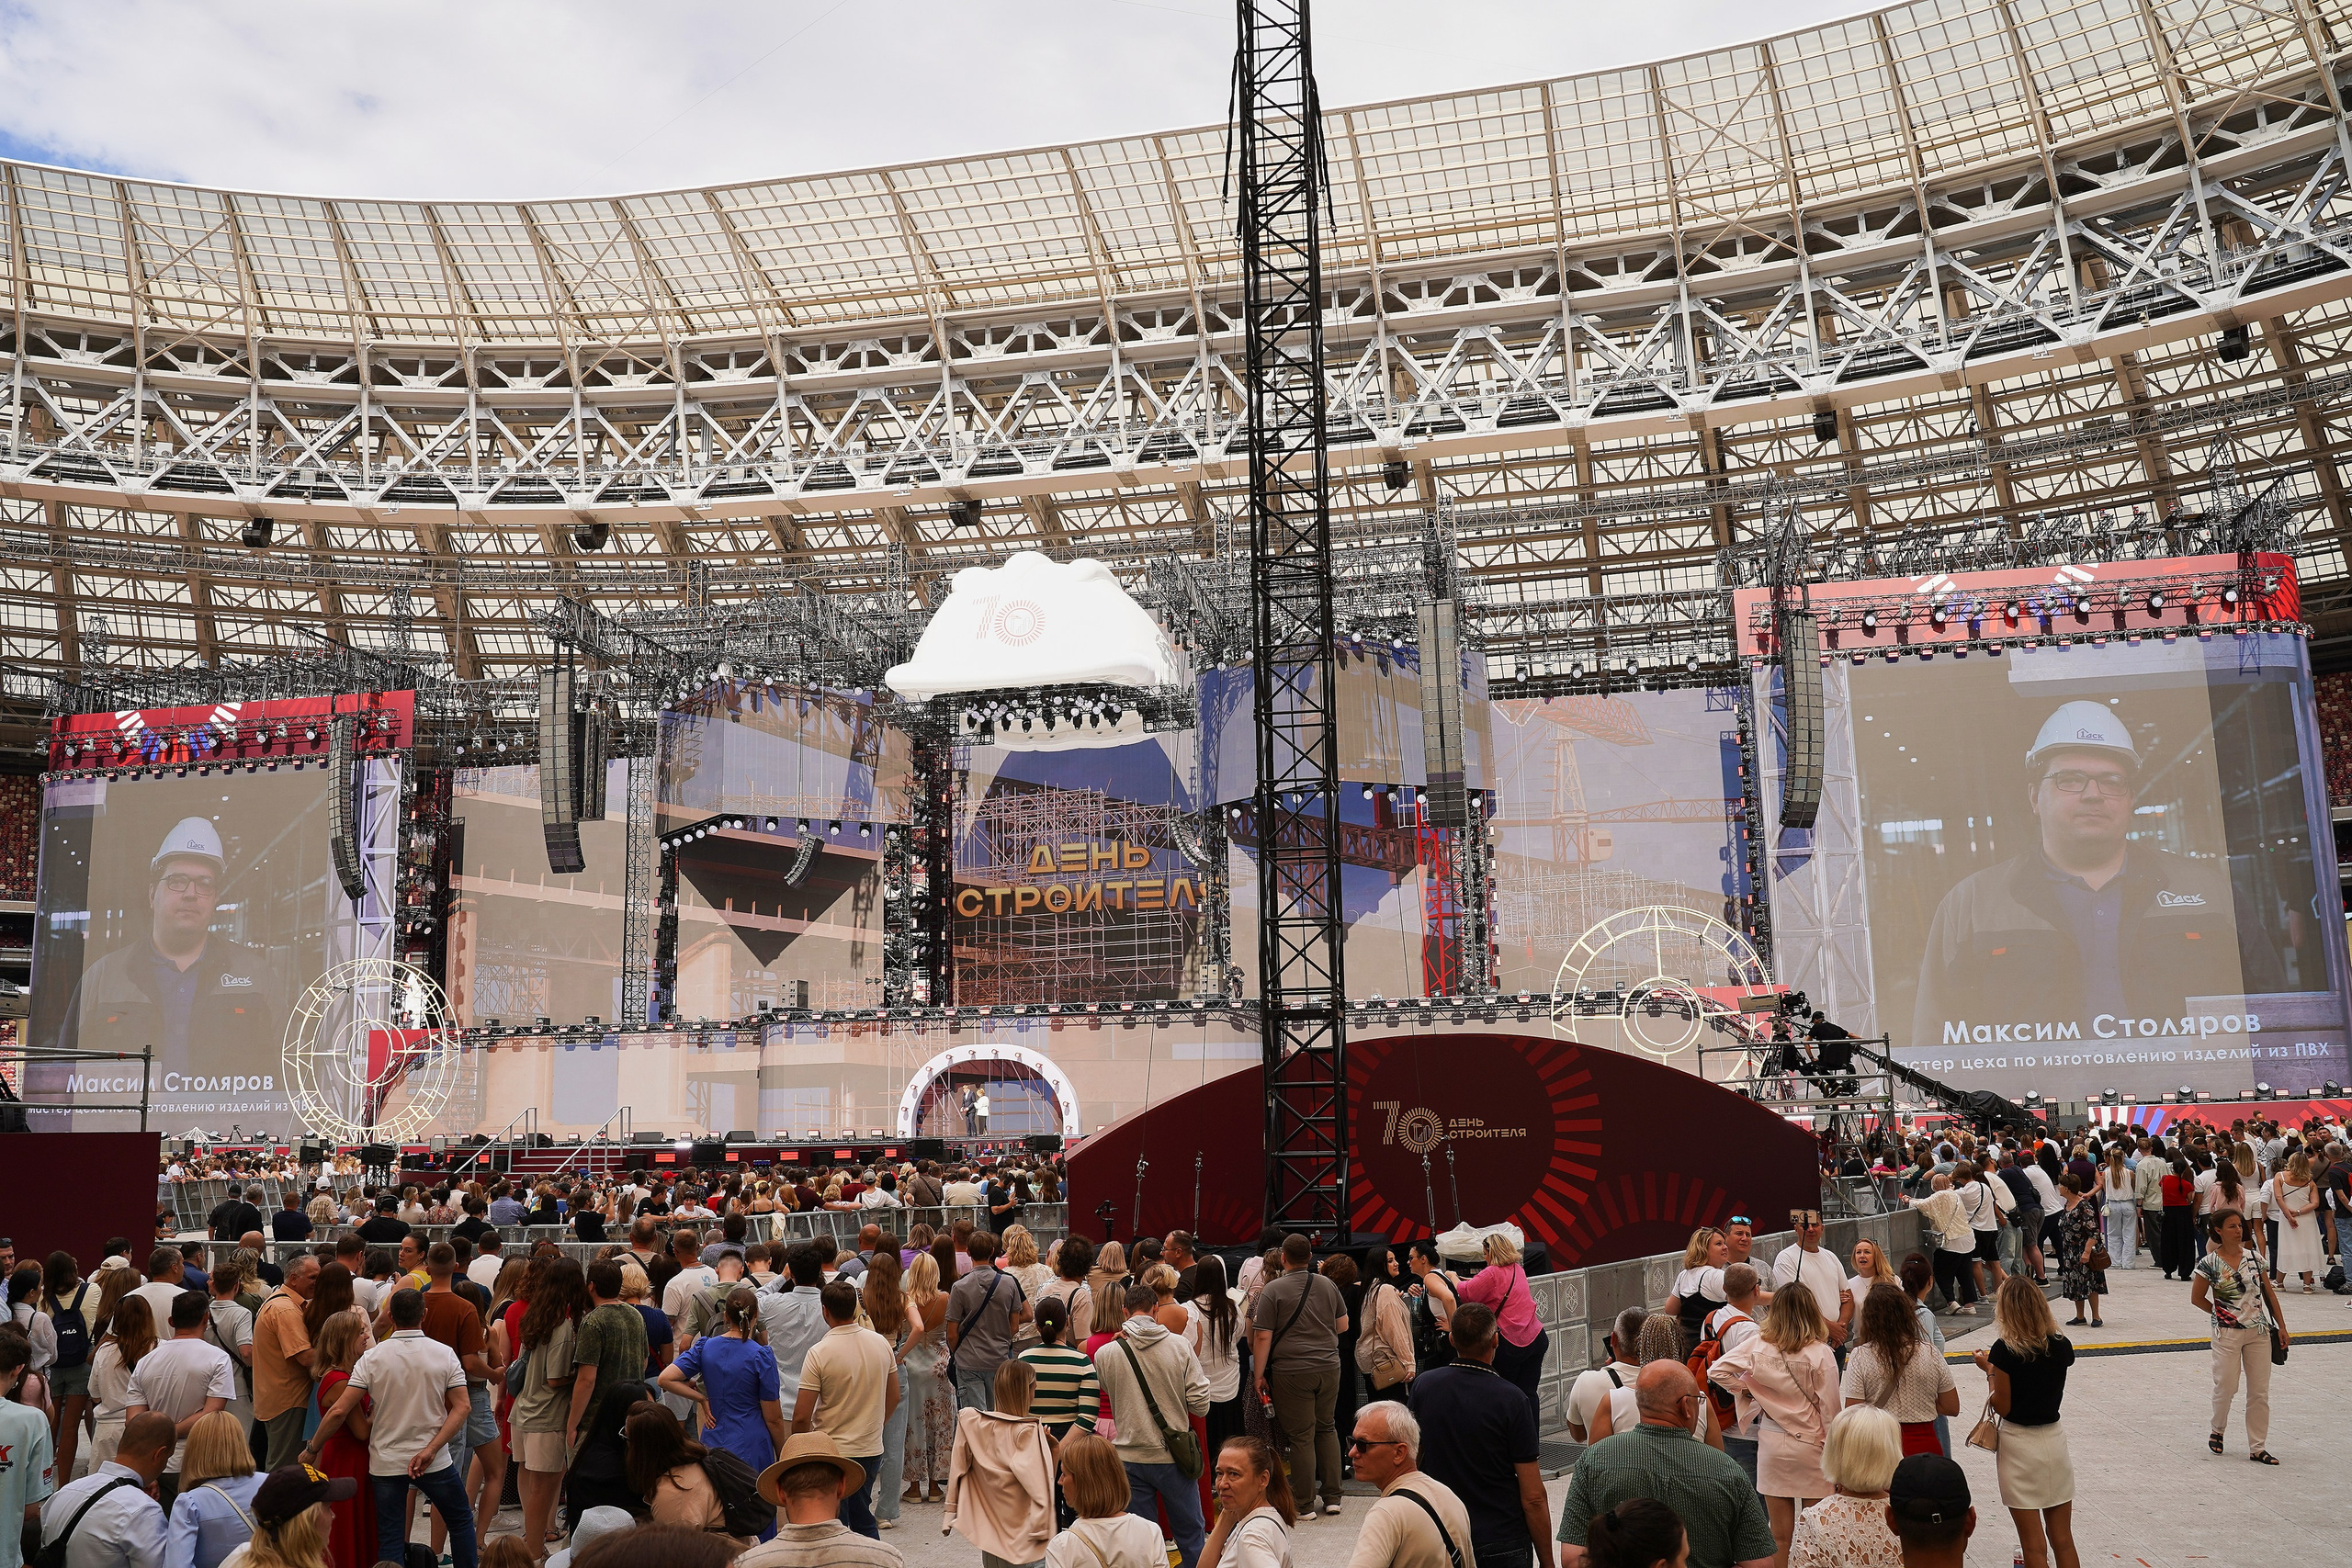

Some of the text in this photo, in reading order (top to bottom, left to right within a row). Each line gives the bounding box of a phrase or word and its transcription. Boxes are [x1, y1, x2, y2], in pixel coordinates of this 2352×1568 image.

[1027, 840, 1150, 874] ДЕНЬ
[1942, 1013, 2261, 1044] Максим Столяров
[1961, 1057, 2007, 1070] цеха
[2014, 1055, 2036, 1066] по
[2042, 1050, 2177, 1066] изготовлению
[2183, 1043, 2261, 1062] изделий
[2268, 1046, 2288, 1057] из
[2295, 1042, 2330, 1055] ПВХ
[164, 1072, 274, 1096] Столяров
[219, 1100, 271, 1112] изделий
[275, 1103, 288, 1111] из
[1448, 1118, 1485, 1127] ДЕНЬ
[1449, 1128, 1527, 1139] СТРОИТЕЛЯ
